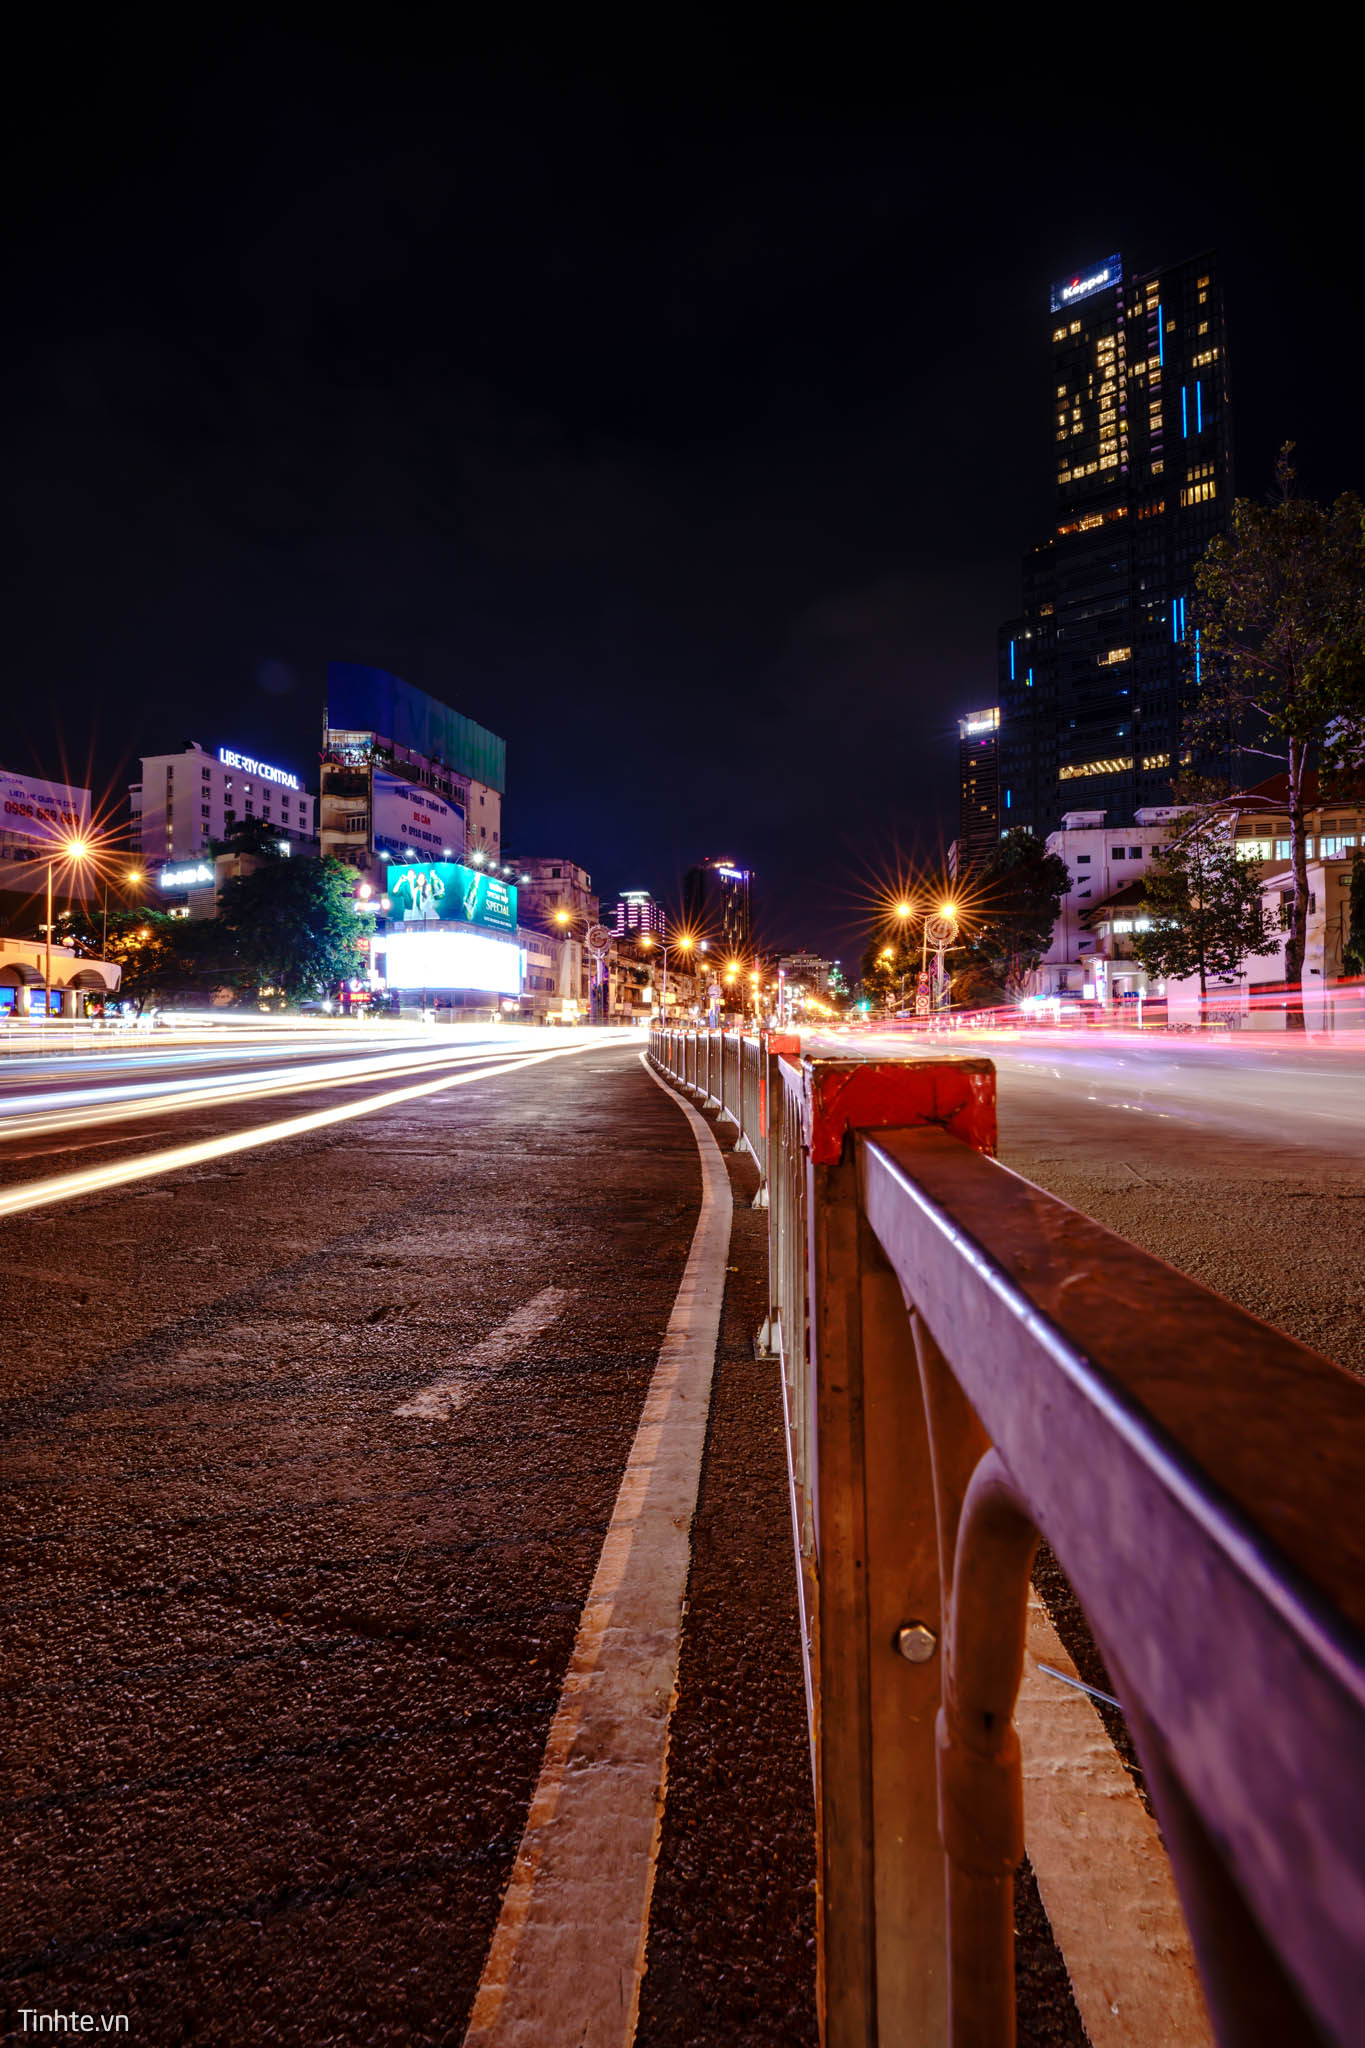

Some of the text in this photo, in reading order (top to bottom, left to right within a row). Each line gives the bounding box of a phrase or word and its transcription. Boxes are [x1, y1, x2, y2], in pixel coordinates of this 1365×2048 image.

[1063, 269, 1108, 300] Keppel
[219, 747, 299, 790] LIBERTY CENTRAL
